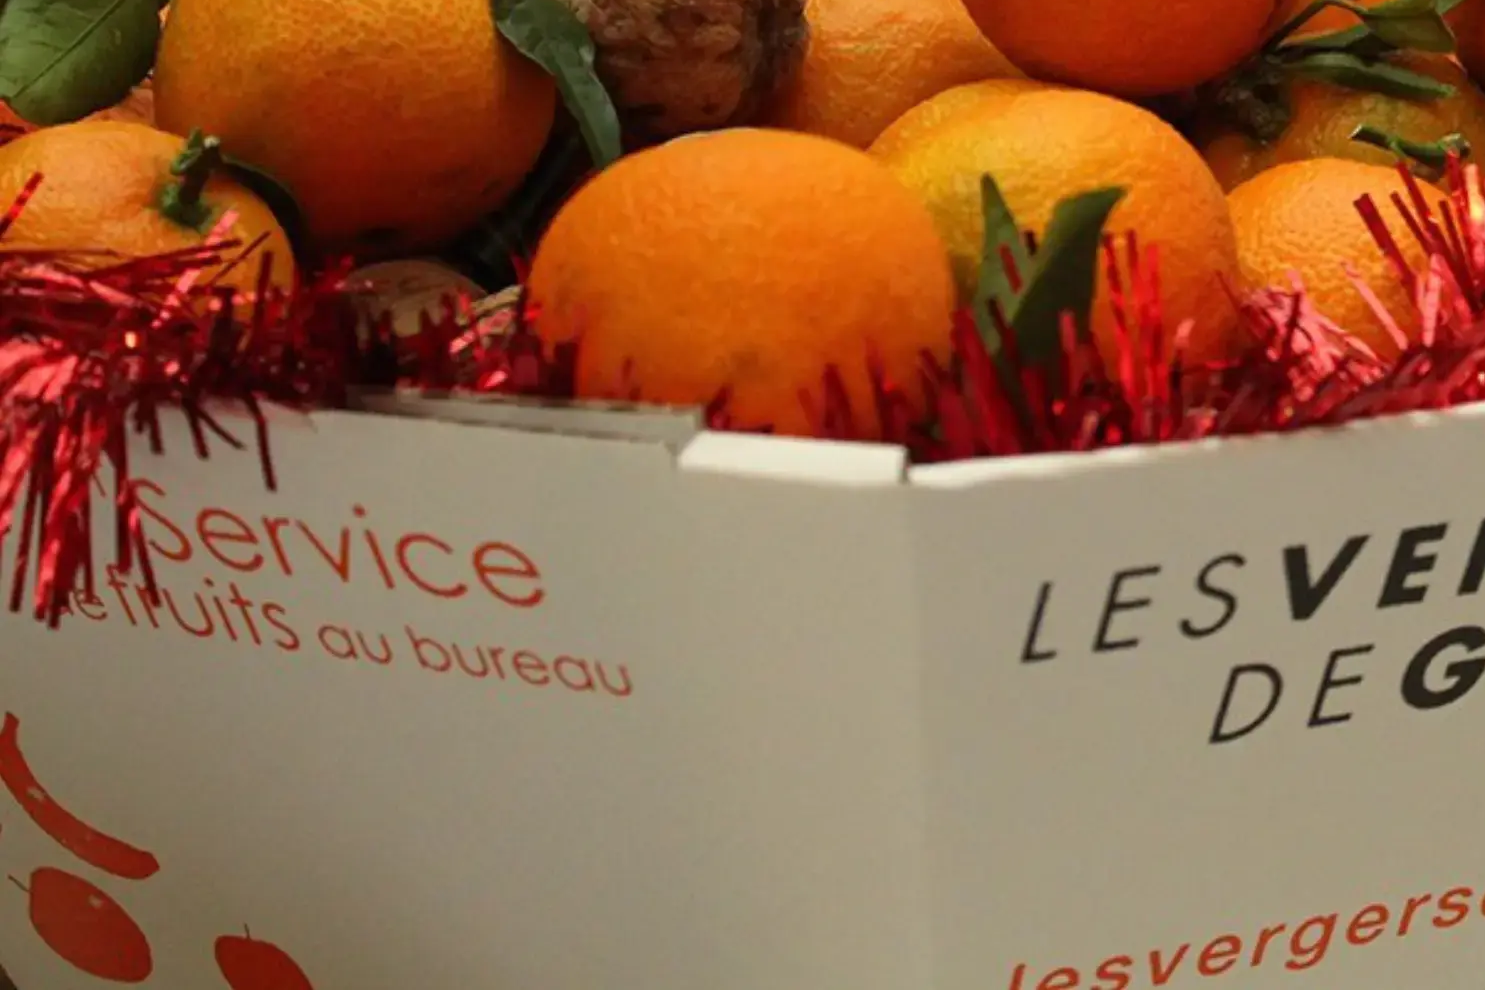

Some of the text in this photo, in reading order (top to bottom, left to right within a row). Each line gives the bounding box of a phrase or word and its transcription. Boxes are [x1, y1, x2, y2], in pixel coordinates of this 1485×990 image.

[128, 477, 546, 608] Service
[106, 563, 300, 651] fruits
[317, 623, 394, 666] au
[405, 625, 633, 697] bureau
